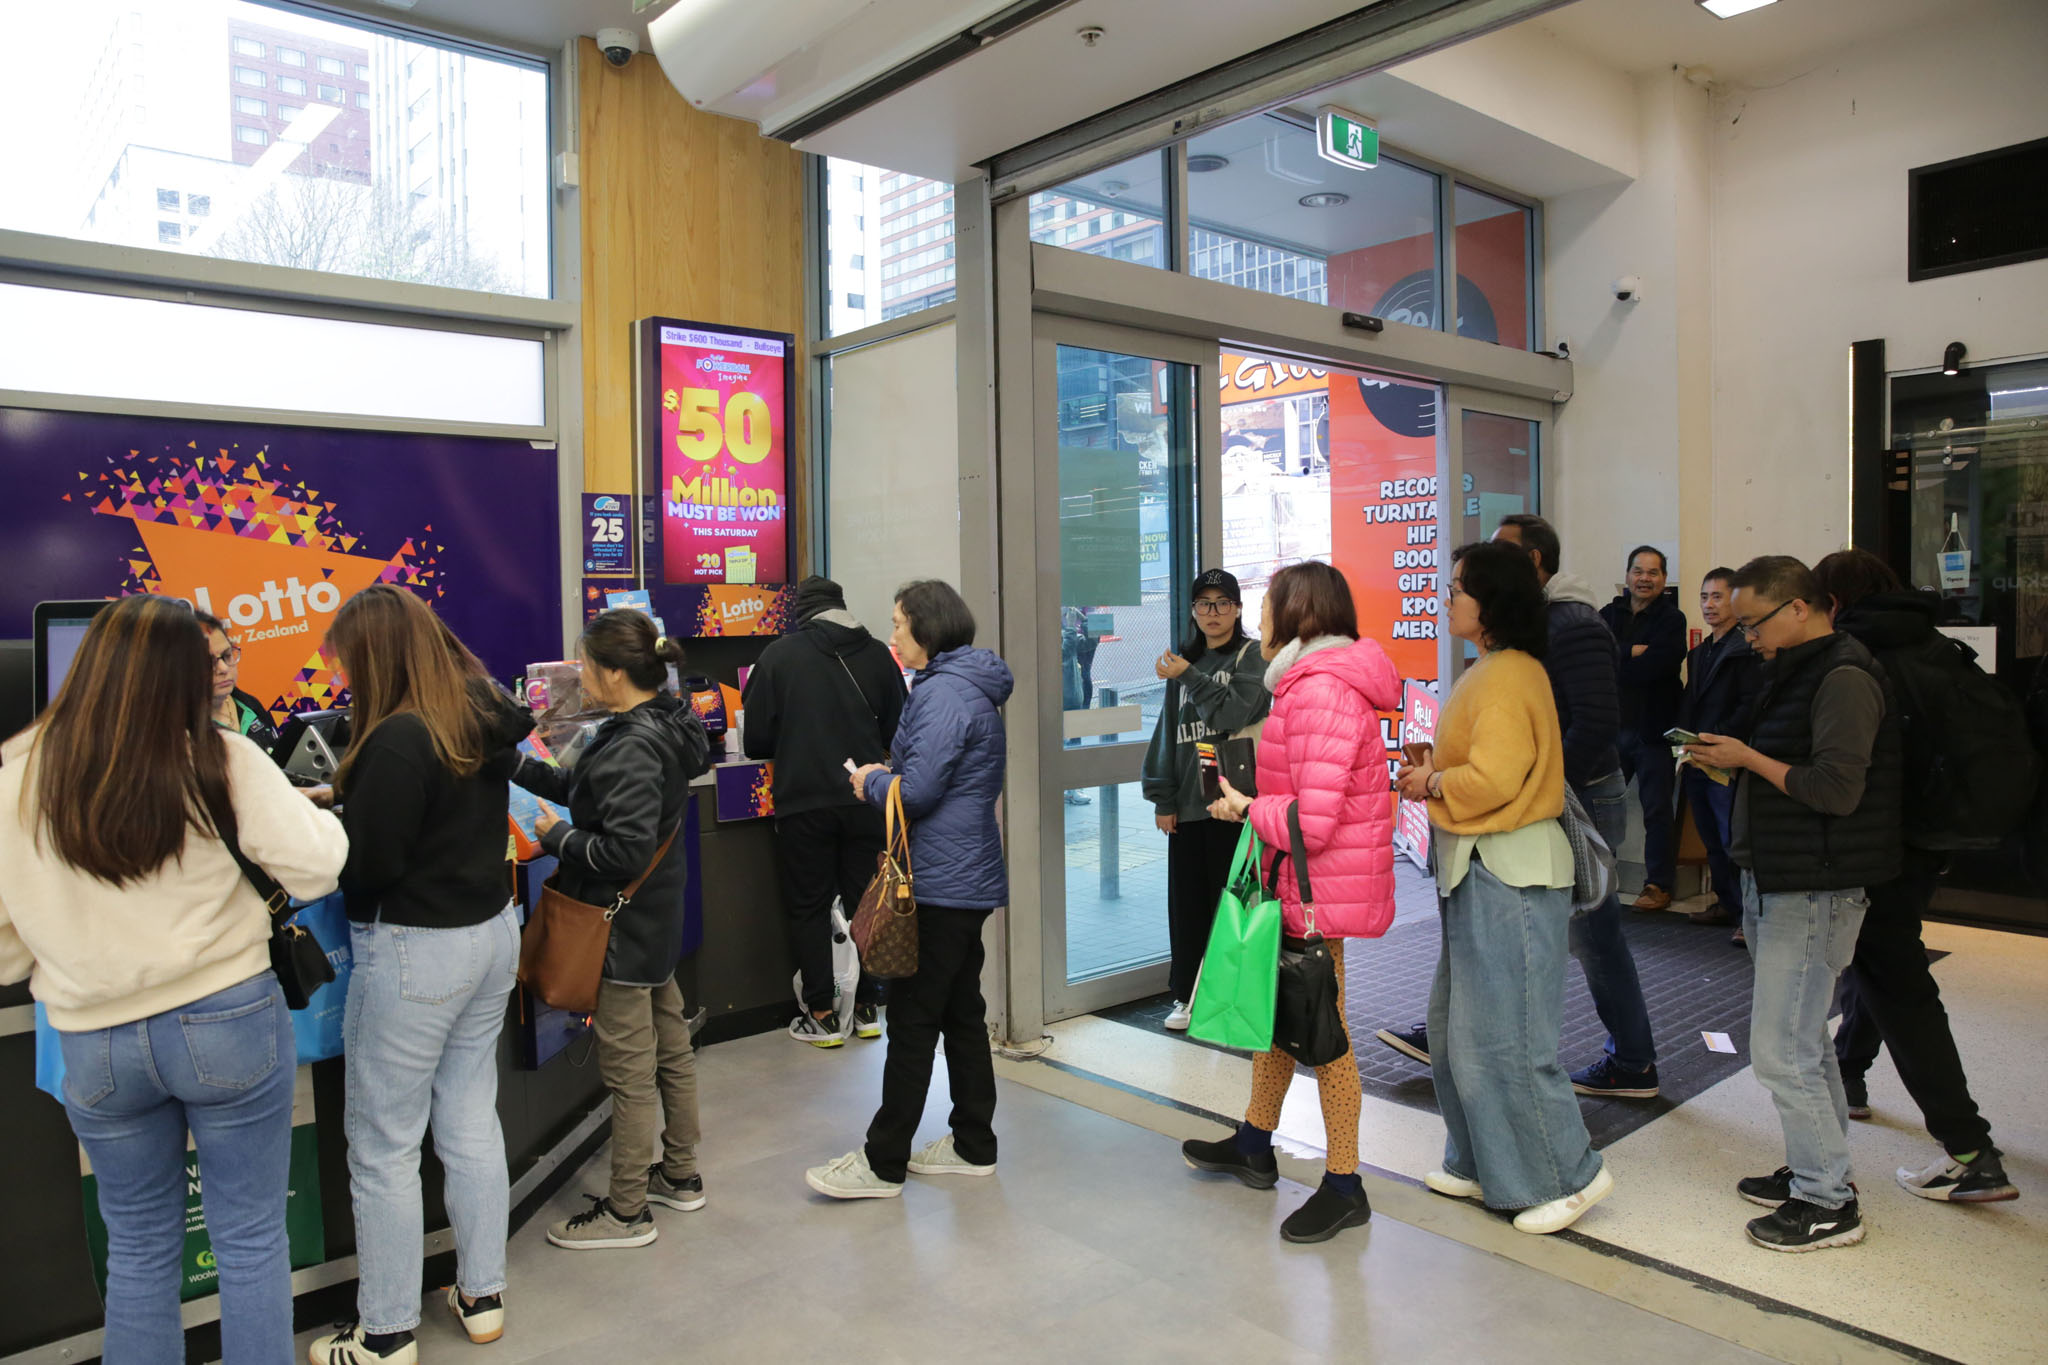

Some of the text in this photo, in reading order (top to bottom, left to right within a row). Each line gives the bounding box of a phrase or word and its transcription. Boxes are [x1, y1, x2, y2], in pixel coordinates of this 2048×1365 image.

[666, 330, 686, 342] Strike
[689, 333, 708, 344] $600
[710, 336, 743, 348] Thousand
[754, 341, 782, 354] Bullseye
[718, 373, 748, 384] Imagine
[663, 386, 772, 464] $50
[672, 475, 777, 507] Million
[668, 502, 780, 522] MUST BE WON
[592, 518, 624, 542] 25
[693, 528, 758, 537] THIS SATURDAY
[1407, 526, 1437, 545] HIF
[696, 553, 720, 568] $20
[1393, 549, 1438, 569] BOO
[1398, 573, 1438, 593] GIFT
[194, 576, 341, 629] Lotto
[721, 598, 764, 618] Lotto
[1402, 597, 1438, 616] KPO
[245, 620, 309, 642] Zealand
[1392, 621, 1438, 639] MER
